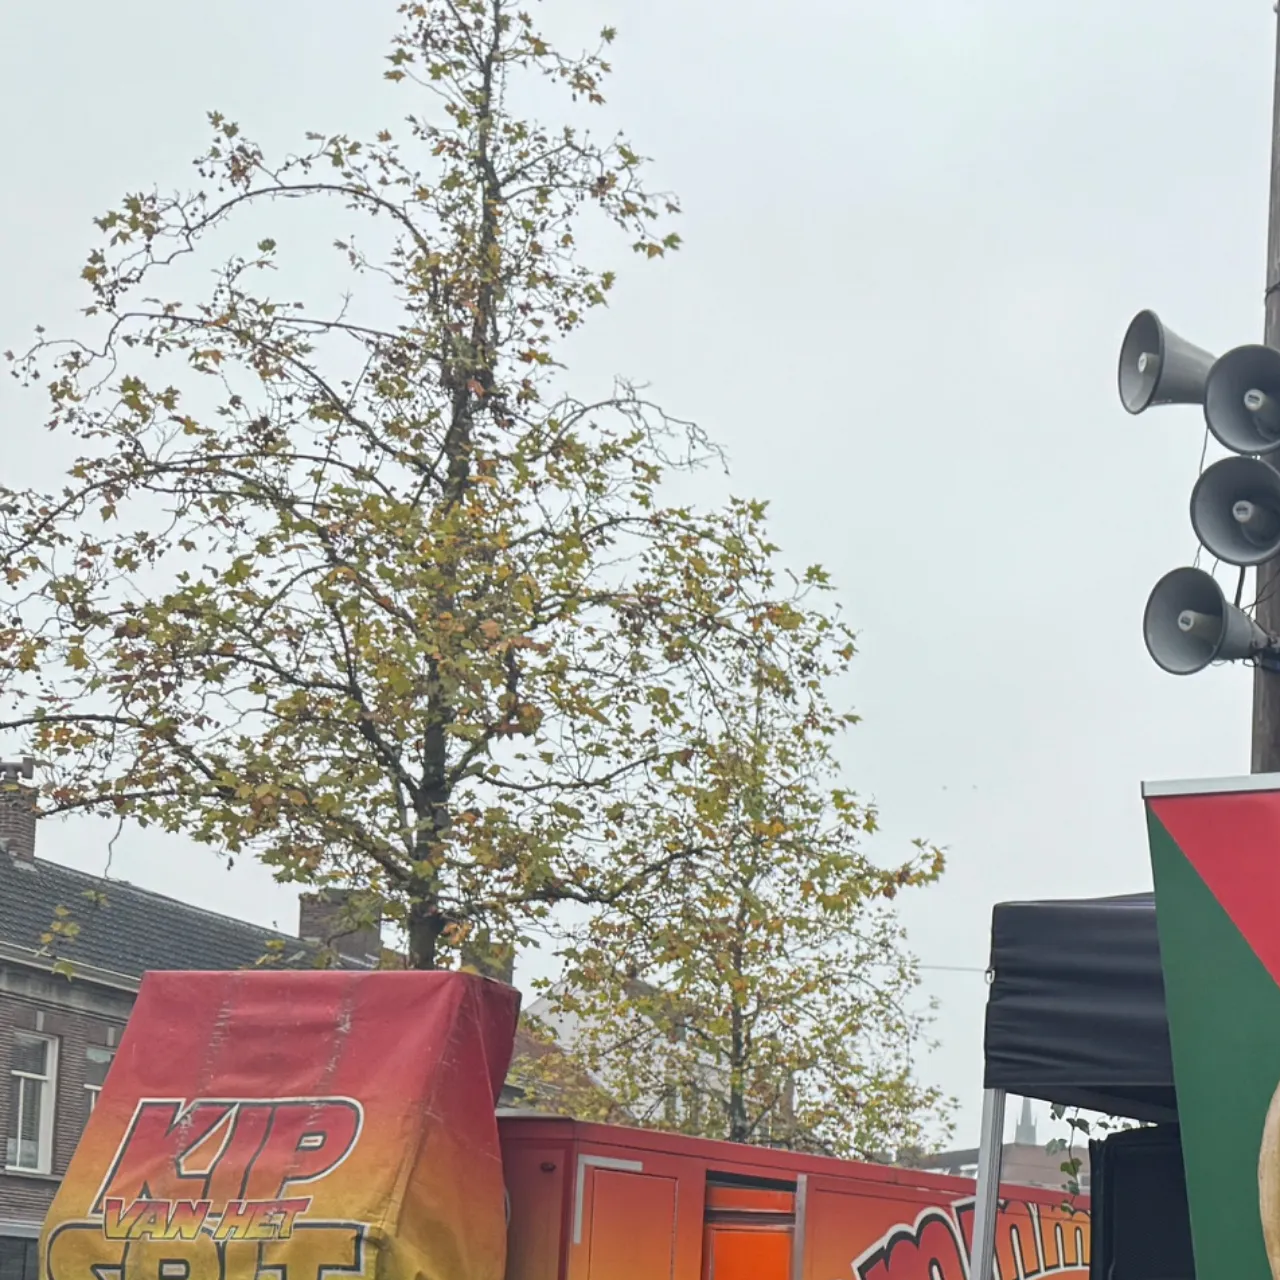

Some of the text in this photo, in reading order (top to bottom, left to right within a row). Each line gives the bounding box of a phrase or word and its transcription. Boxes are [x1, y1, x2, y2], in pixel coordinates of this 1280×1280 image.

[90, 1096, 364, 1217] KIP
[101, 1194, 314, 1241] VAN HET
